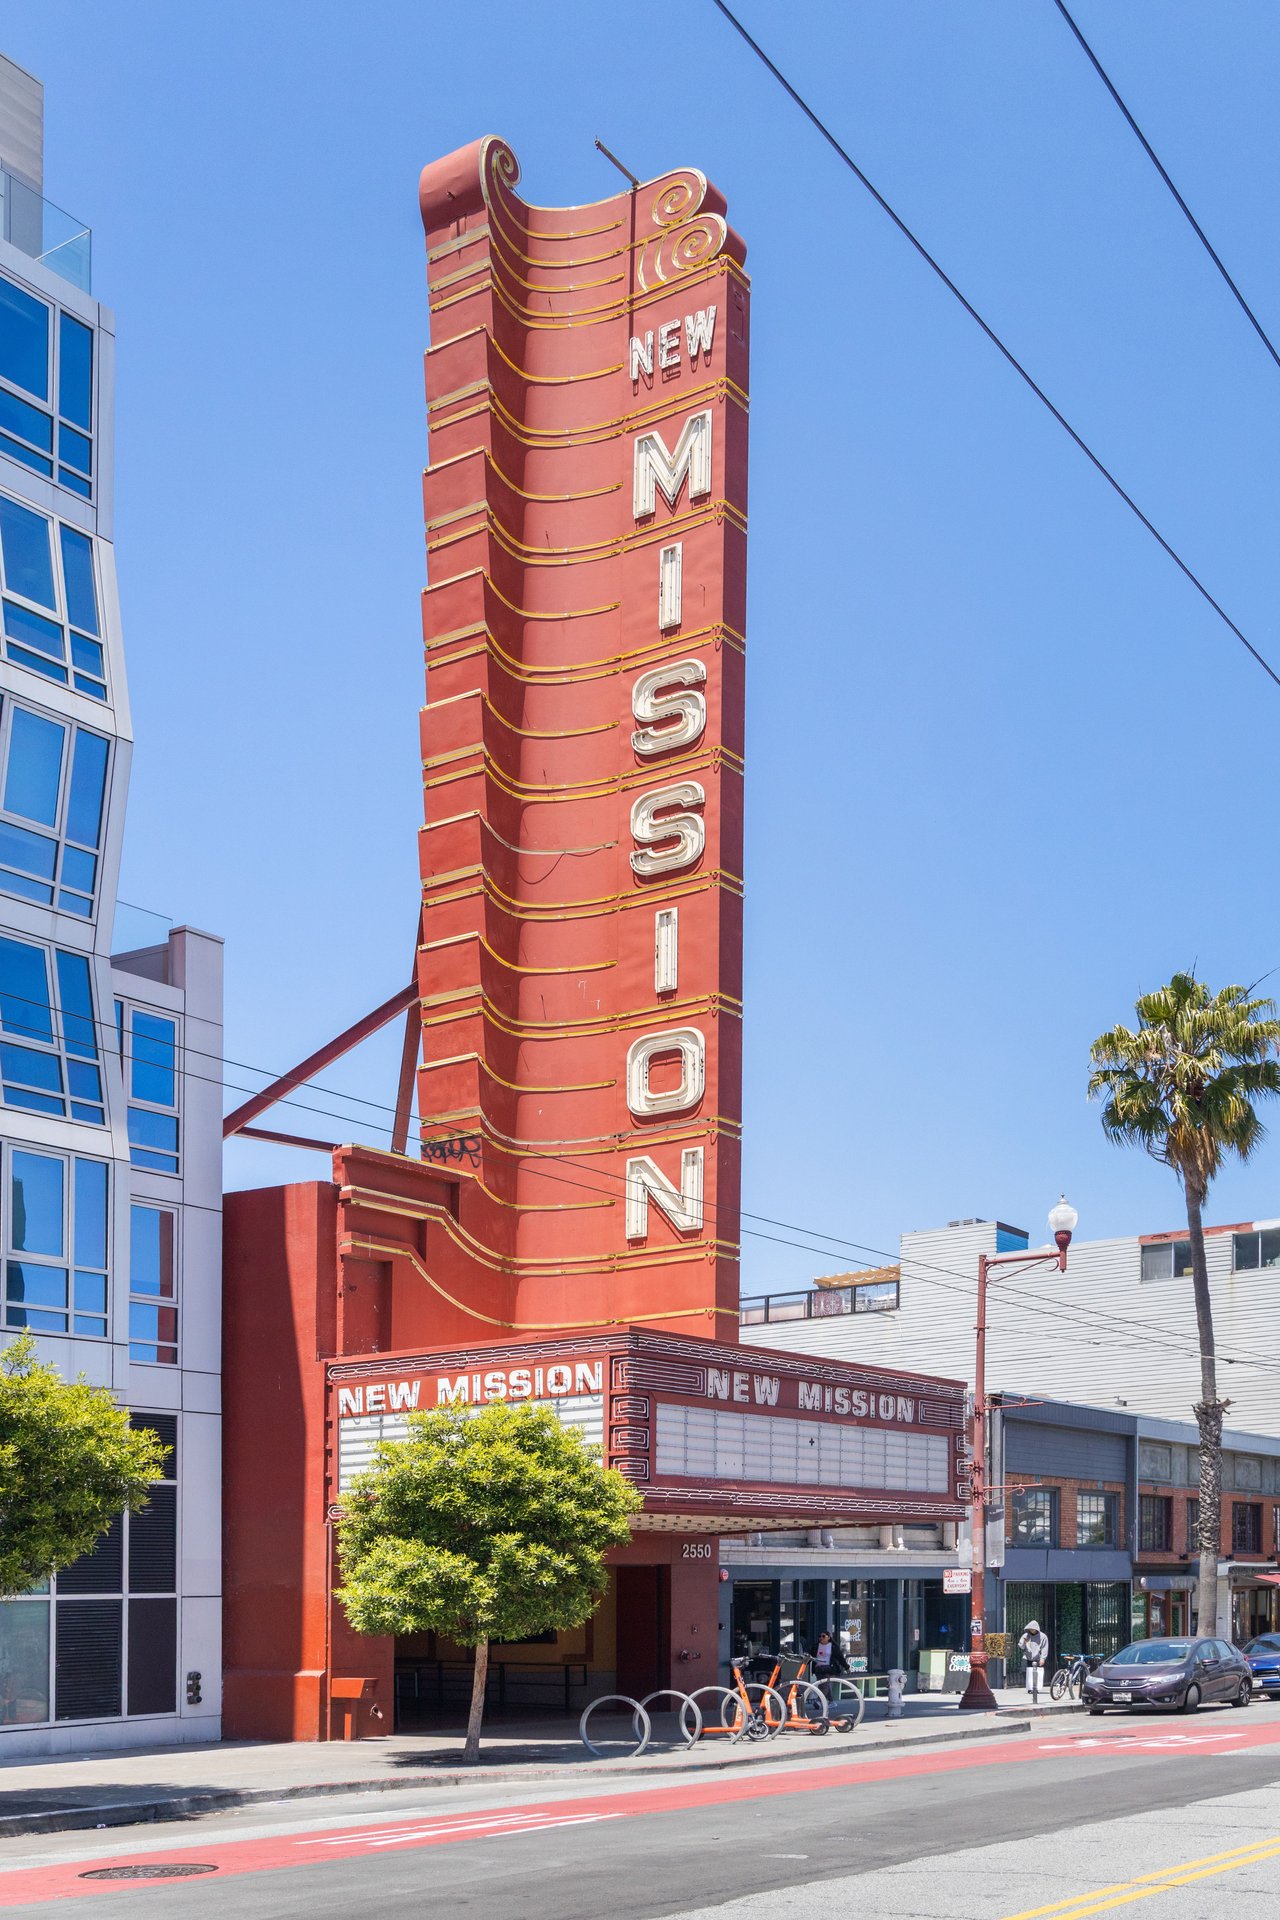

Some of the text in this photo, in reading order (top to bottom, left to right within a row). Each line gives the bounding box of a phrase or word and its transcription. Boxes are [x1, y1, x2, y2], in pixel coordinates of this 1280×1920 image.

[630, 304, 717, 382] NEW
[626, 407, 712, 1240] MISSION
[337, 1361, 603, 1415] NEW MISSION
[707, 1368, 914, 1423] NEW MISSION
[682, 1543, 712, 1559] 2550
[950, 1655, 970, 1665] GRAN
